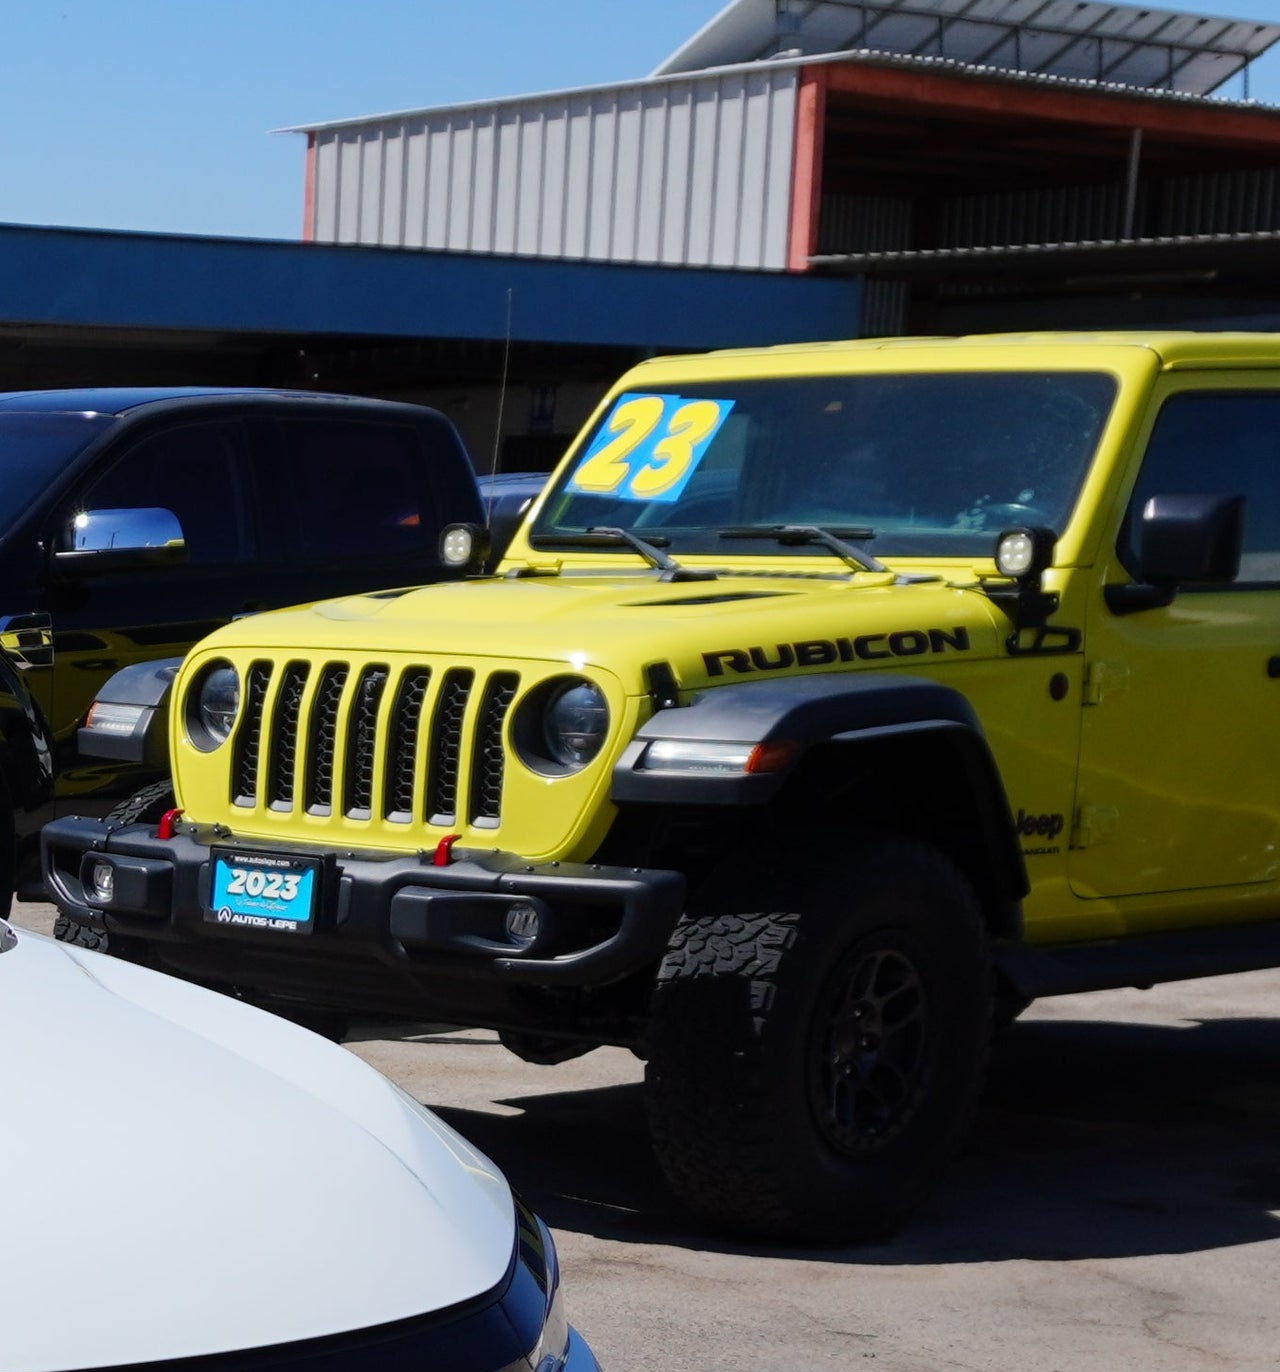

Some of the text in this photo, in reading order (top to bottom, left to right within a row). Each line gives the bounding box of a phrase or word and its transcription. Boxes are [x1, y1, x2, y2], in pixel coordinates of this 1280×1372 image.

[573, 396, 720, 498] 23
[701, 626, 970, 678] RUBICON
[1017, 808, 1064, 840] Jeep
[227, 869, 302, 901] 2023
